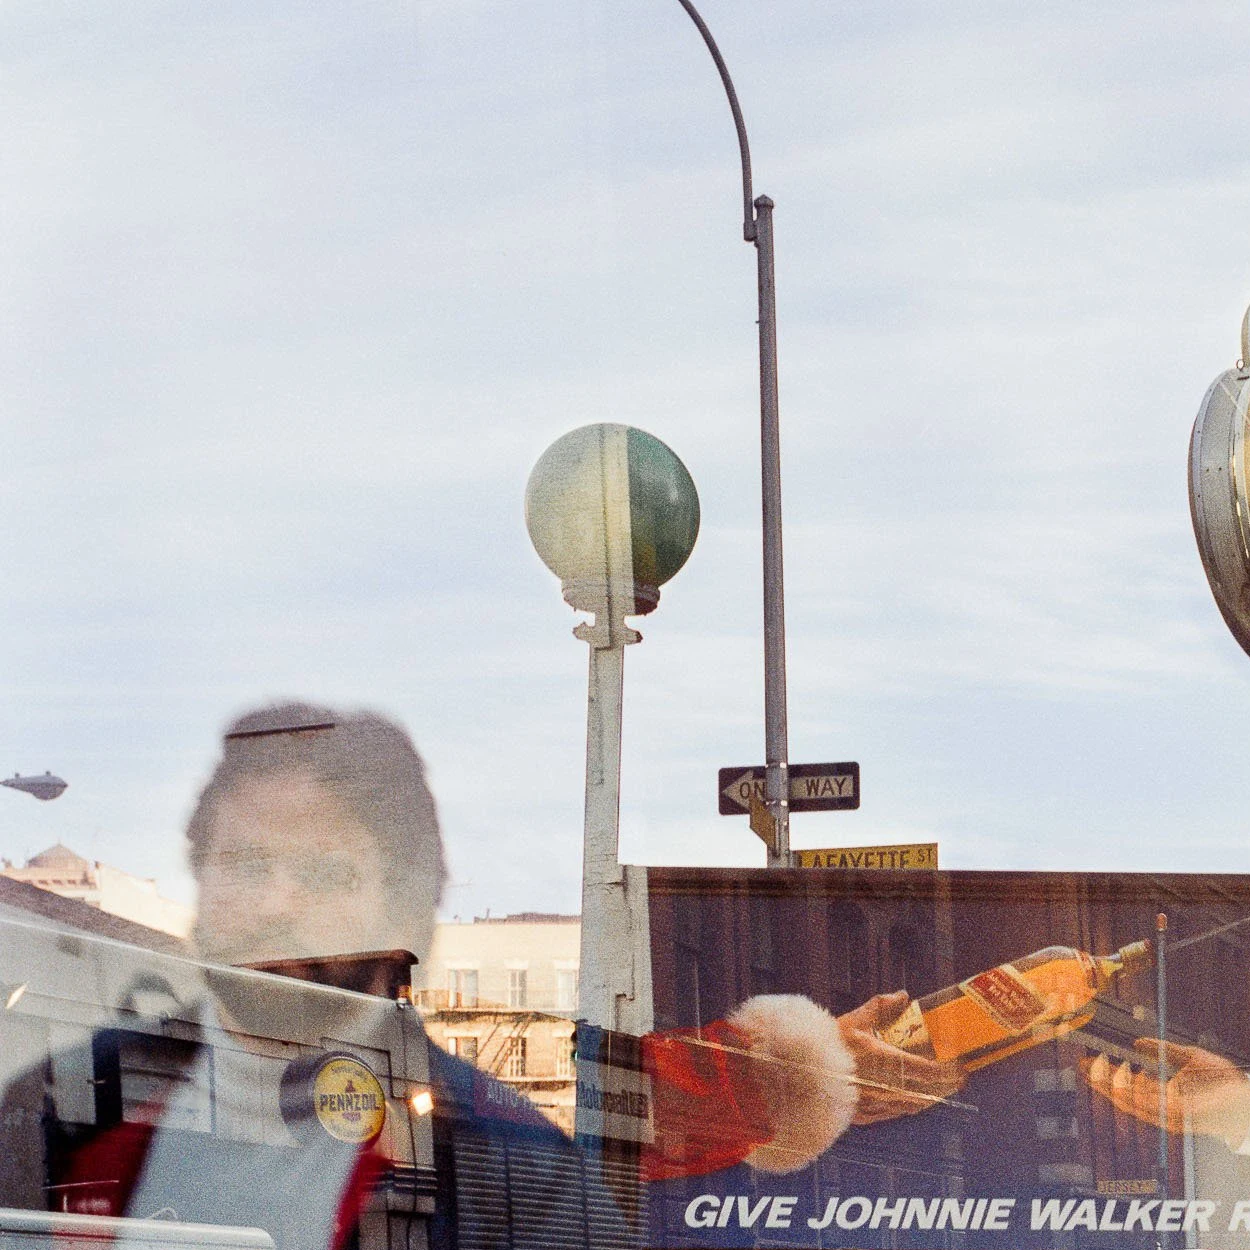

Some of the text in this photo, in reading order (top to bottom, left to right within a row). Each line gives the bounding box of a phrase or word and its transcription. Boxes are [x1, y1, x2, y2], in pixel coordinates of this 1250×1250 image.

[739, 777, 846, 799] ON WAY
[917, 848, 933, 863] ST
[318, 1093, 382, 1112] PENNZOIL
[684, 1195, 798, 1228] GIVE
[807, 1196, 1016, 1230] JOHNNIE
[1030, 1198, 1216, 1232] WALKER
